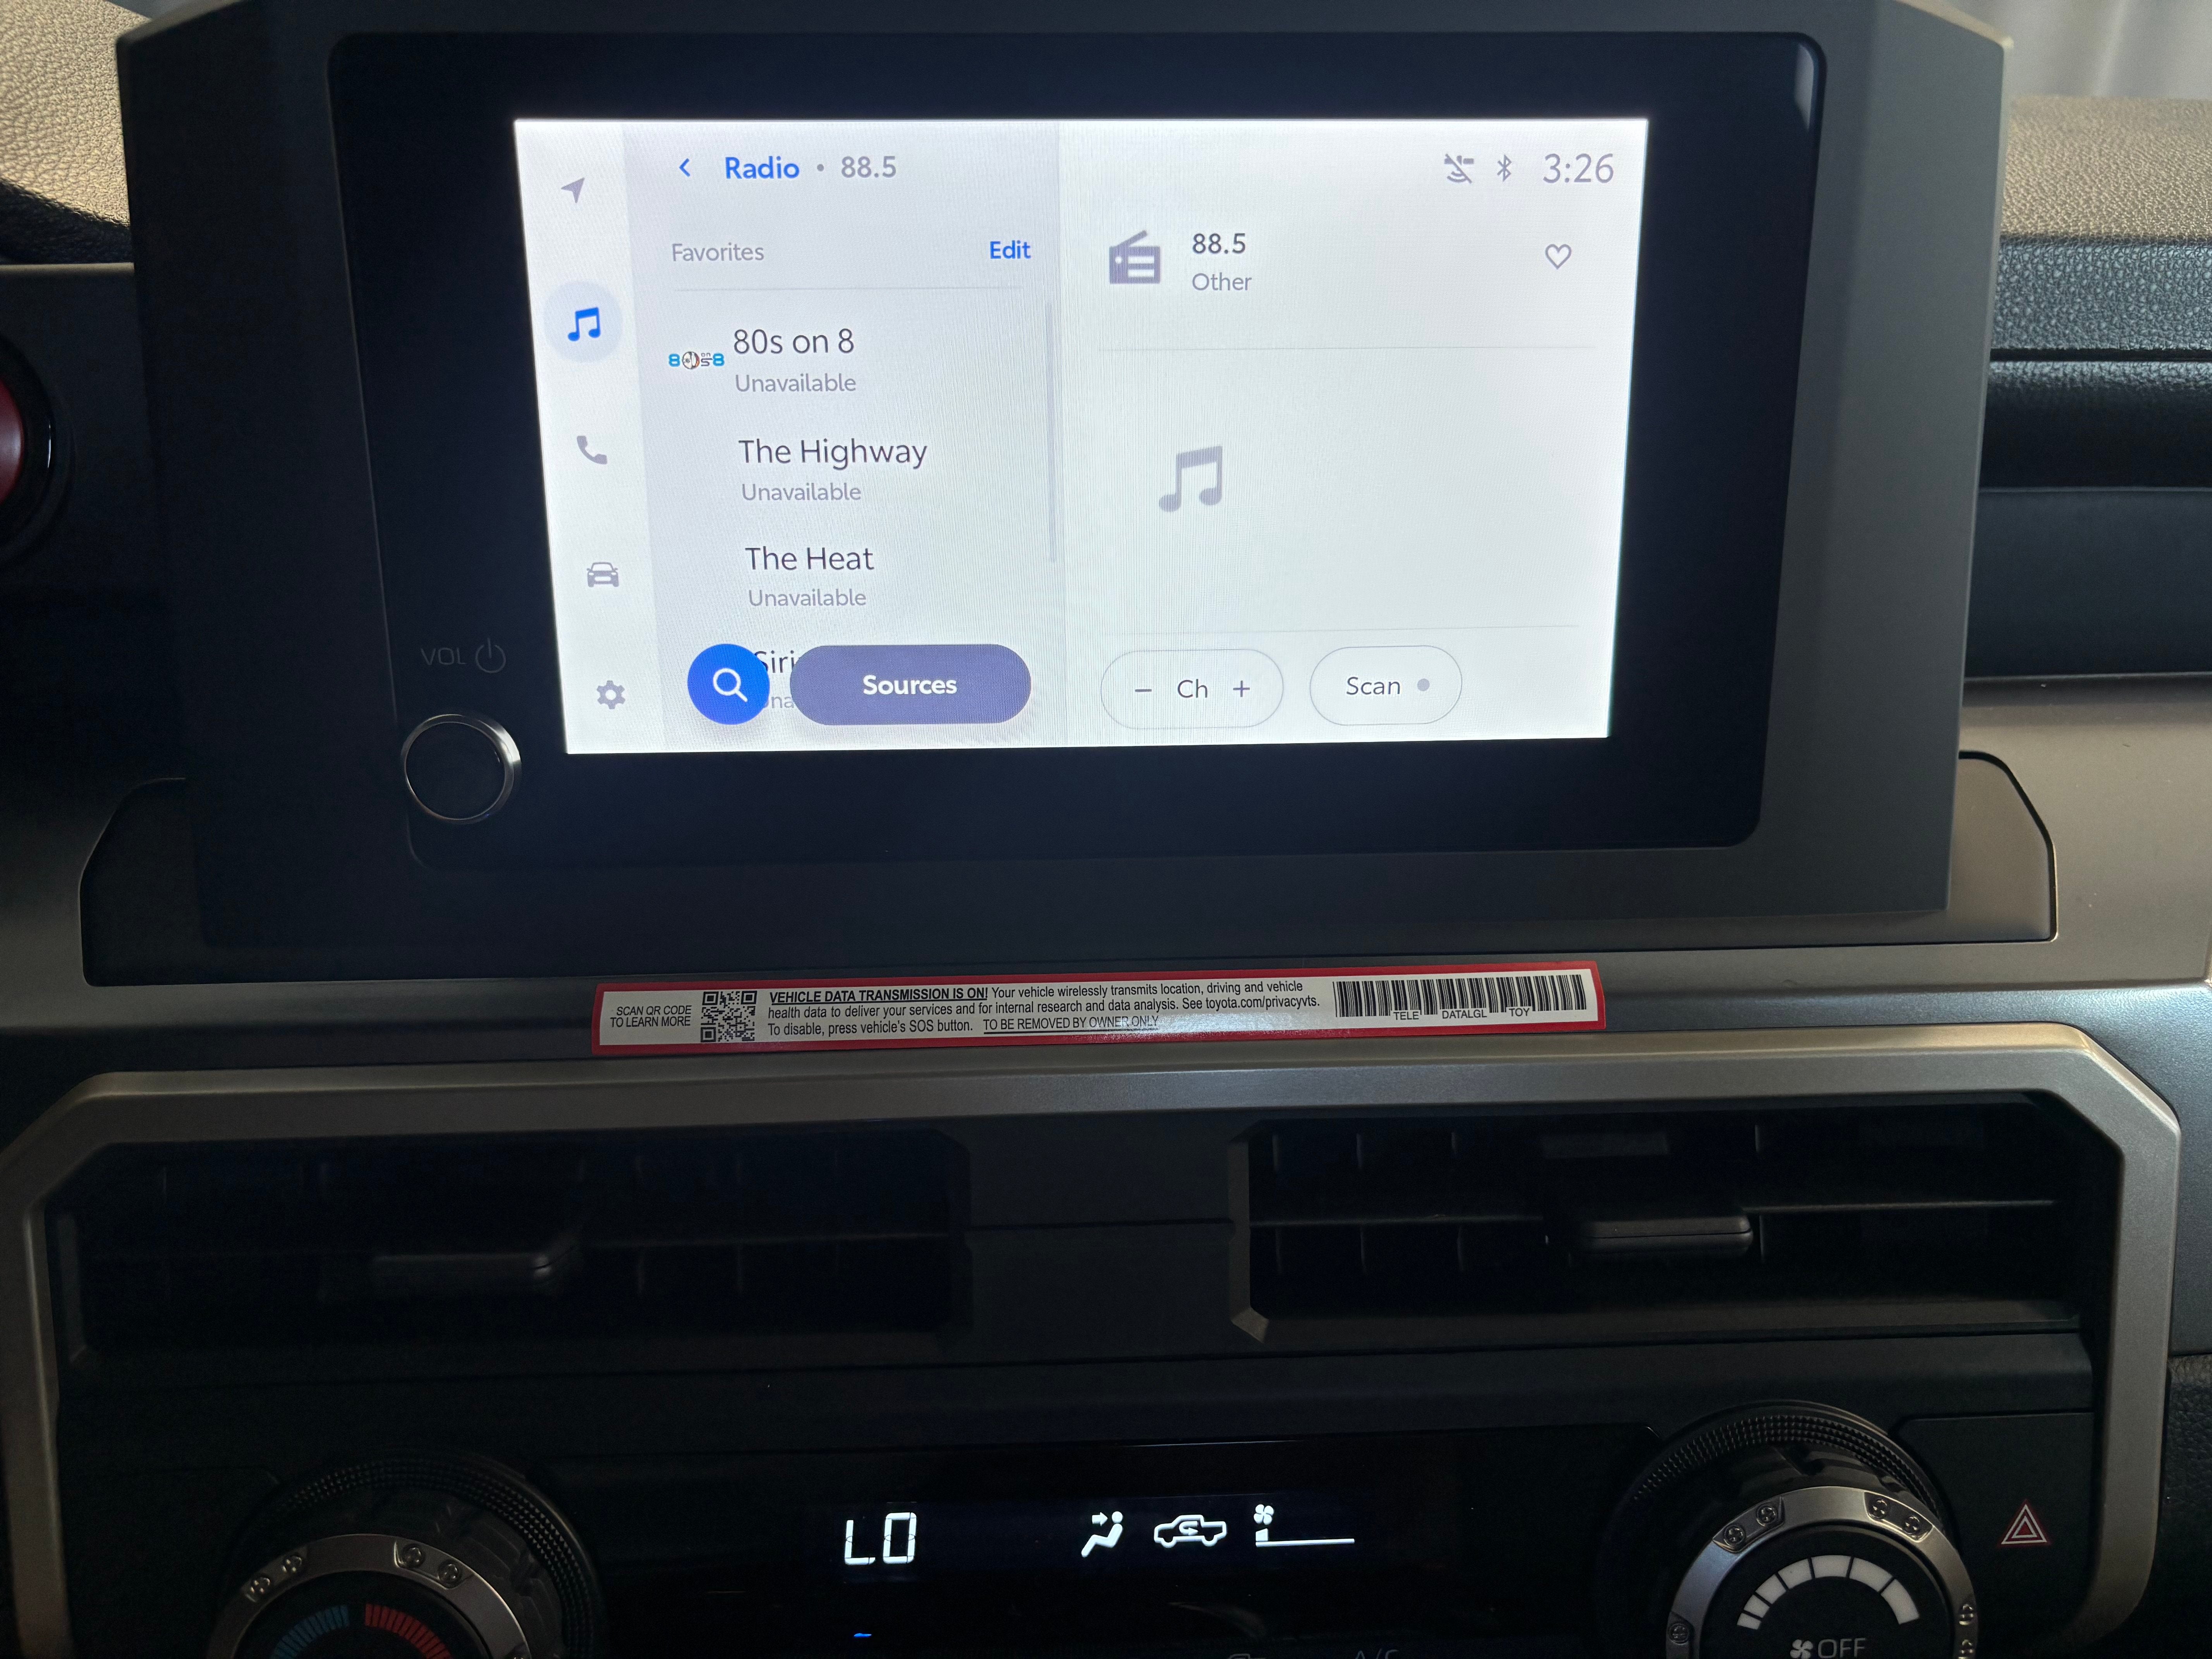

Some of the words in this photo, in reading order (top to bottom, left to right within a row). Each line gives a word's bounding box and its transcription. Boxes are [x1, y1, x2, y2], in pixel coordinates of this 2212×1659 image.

[725, 156, 800, 180] Radio
[841, 156, 897, 179] 88.5
[1543, 153, 1614, 184] 3:26
[672, 242, 765, 262] Favorites
[989, 240, 1032, 260] Edit
[1192, 232, 1247, 254] 88.5
[1192, 273, 1253, 292] Other
[733, 329, 783, 355] 80s
[793, 335, 829, 354] on
[838, 328, 855, 354] 8
[735, 374, 857, 393] Unavailable
[738, 440, 792, 464] The
[801, 439, 928, 470] Highway
[741, 482, 862, 502] Unavailable
[745, 547, 797, 570] The
[807, 546, 874, 571] Heat
[748, 589, 867, 608] Unavailable
[421, 647, 467, 665] VOL
[754, 650, 796, 673] Siri
[862, 675, 958, 696] Sources
[1177, 679, 1208, 699] Ch
[1346, 676, 1401, 696] Scan
[770, 991, 821, 1003] VEHICLE
[825, 990, 856, 1002] DATA
[859, 988, 949, 1001] TRANSMISSION
[953, 988, 963, 999] IS
[967, 987, 988, 998] ON!
[992, 987, 1015, 998] Your
[1018, 986, 1054, 998] vehicle
[1058, 985, 1107, 998] wirelessly
[1111, 984, 1158, 995] transmits
[1161, 983, 1203, 995] location,
[1207, 982, 1241, 995] driving
[1245, 981, 1264, 993] and
[1267, 980, 1303, 992] vehicle
[617, 1006, 643, 1016] SCAN
[646, 1006, 661, 1016] QR
[663, 1005, 692, 1015] CODE
[768, 1007, 800, 1018] health
[804, 1006, 827, 1018] data
[831, 1006, 841, 1017] to
[845, 1005, 880, 1017] deliver
[883, 1007, 906, 1019] your
[910, 1003, 952, 1016] services
[956, 1003, 975, 1014] and
[979, 1002, 993, 1013] for
[996, 1001, 1034, 1013] internal
[1037, 1000, 1082, 1012] research
[1085, 1000, 1104, 1011] and
[1108, 999, 1130, 1010] data
[1134, 998, 1179, 1013] analysis.
[1182, 997, 1202, 1009] See
[1206, 995, 1320, 1012] toyota.com/privacyvts.
[1393, 1011, 1419, 1020] TELE
[1442, 1009, 1487, 1019] DATALGL
[1509, 1008, 1530, 1017] TOY
[610, 1017, 623, 1027] TO
[626, 1017, 658, 1027] LEARN
[661, 1016, 690, 1027] MORE
[768, 1023, 780, 1036] To
[784, 1022, 824, 1036] disable,
[828, 1024, 857, 1037] press
[860, 1020, 906, 1033] vehicle's
[910, 1019, 934, 1032] SOS
[937, 1019, 973, 1032] button.
[983, 1019, 998, 1030] TO
[1001, 1018, 1014, 1029] BE
[1017, 1017, 1070, 1029] REMOVED
[1073, 1017, 1087, 1028] BY
[1089, 1016, 1129, 1027] OWNER
[1132, 1015, 1159, 1027] ONLY
[1818, 1638, 1866, 1659] OFF
